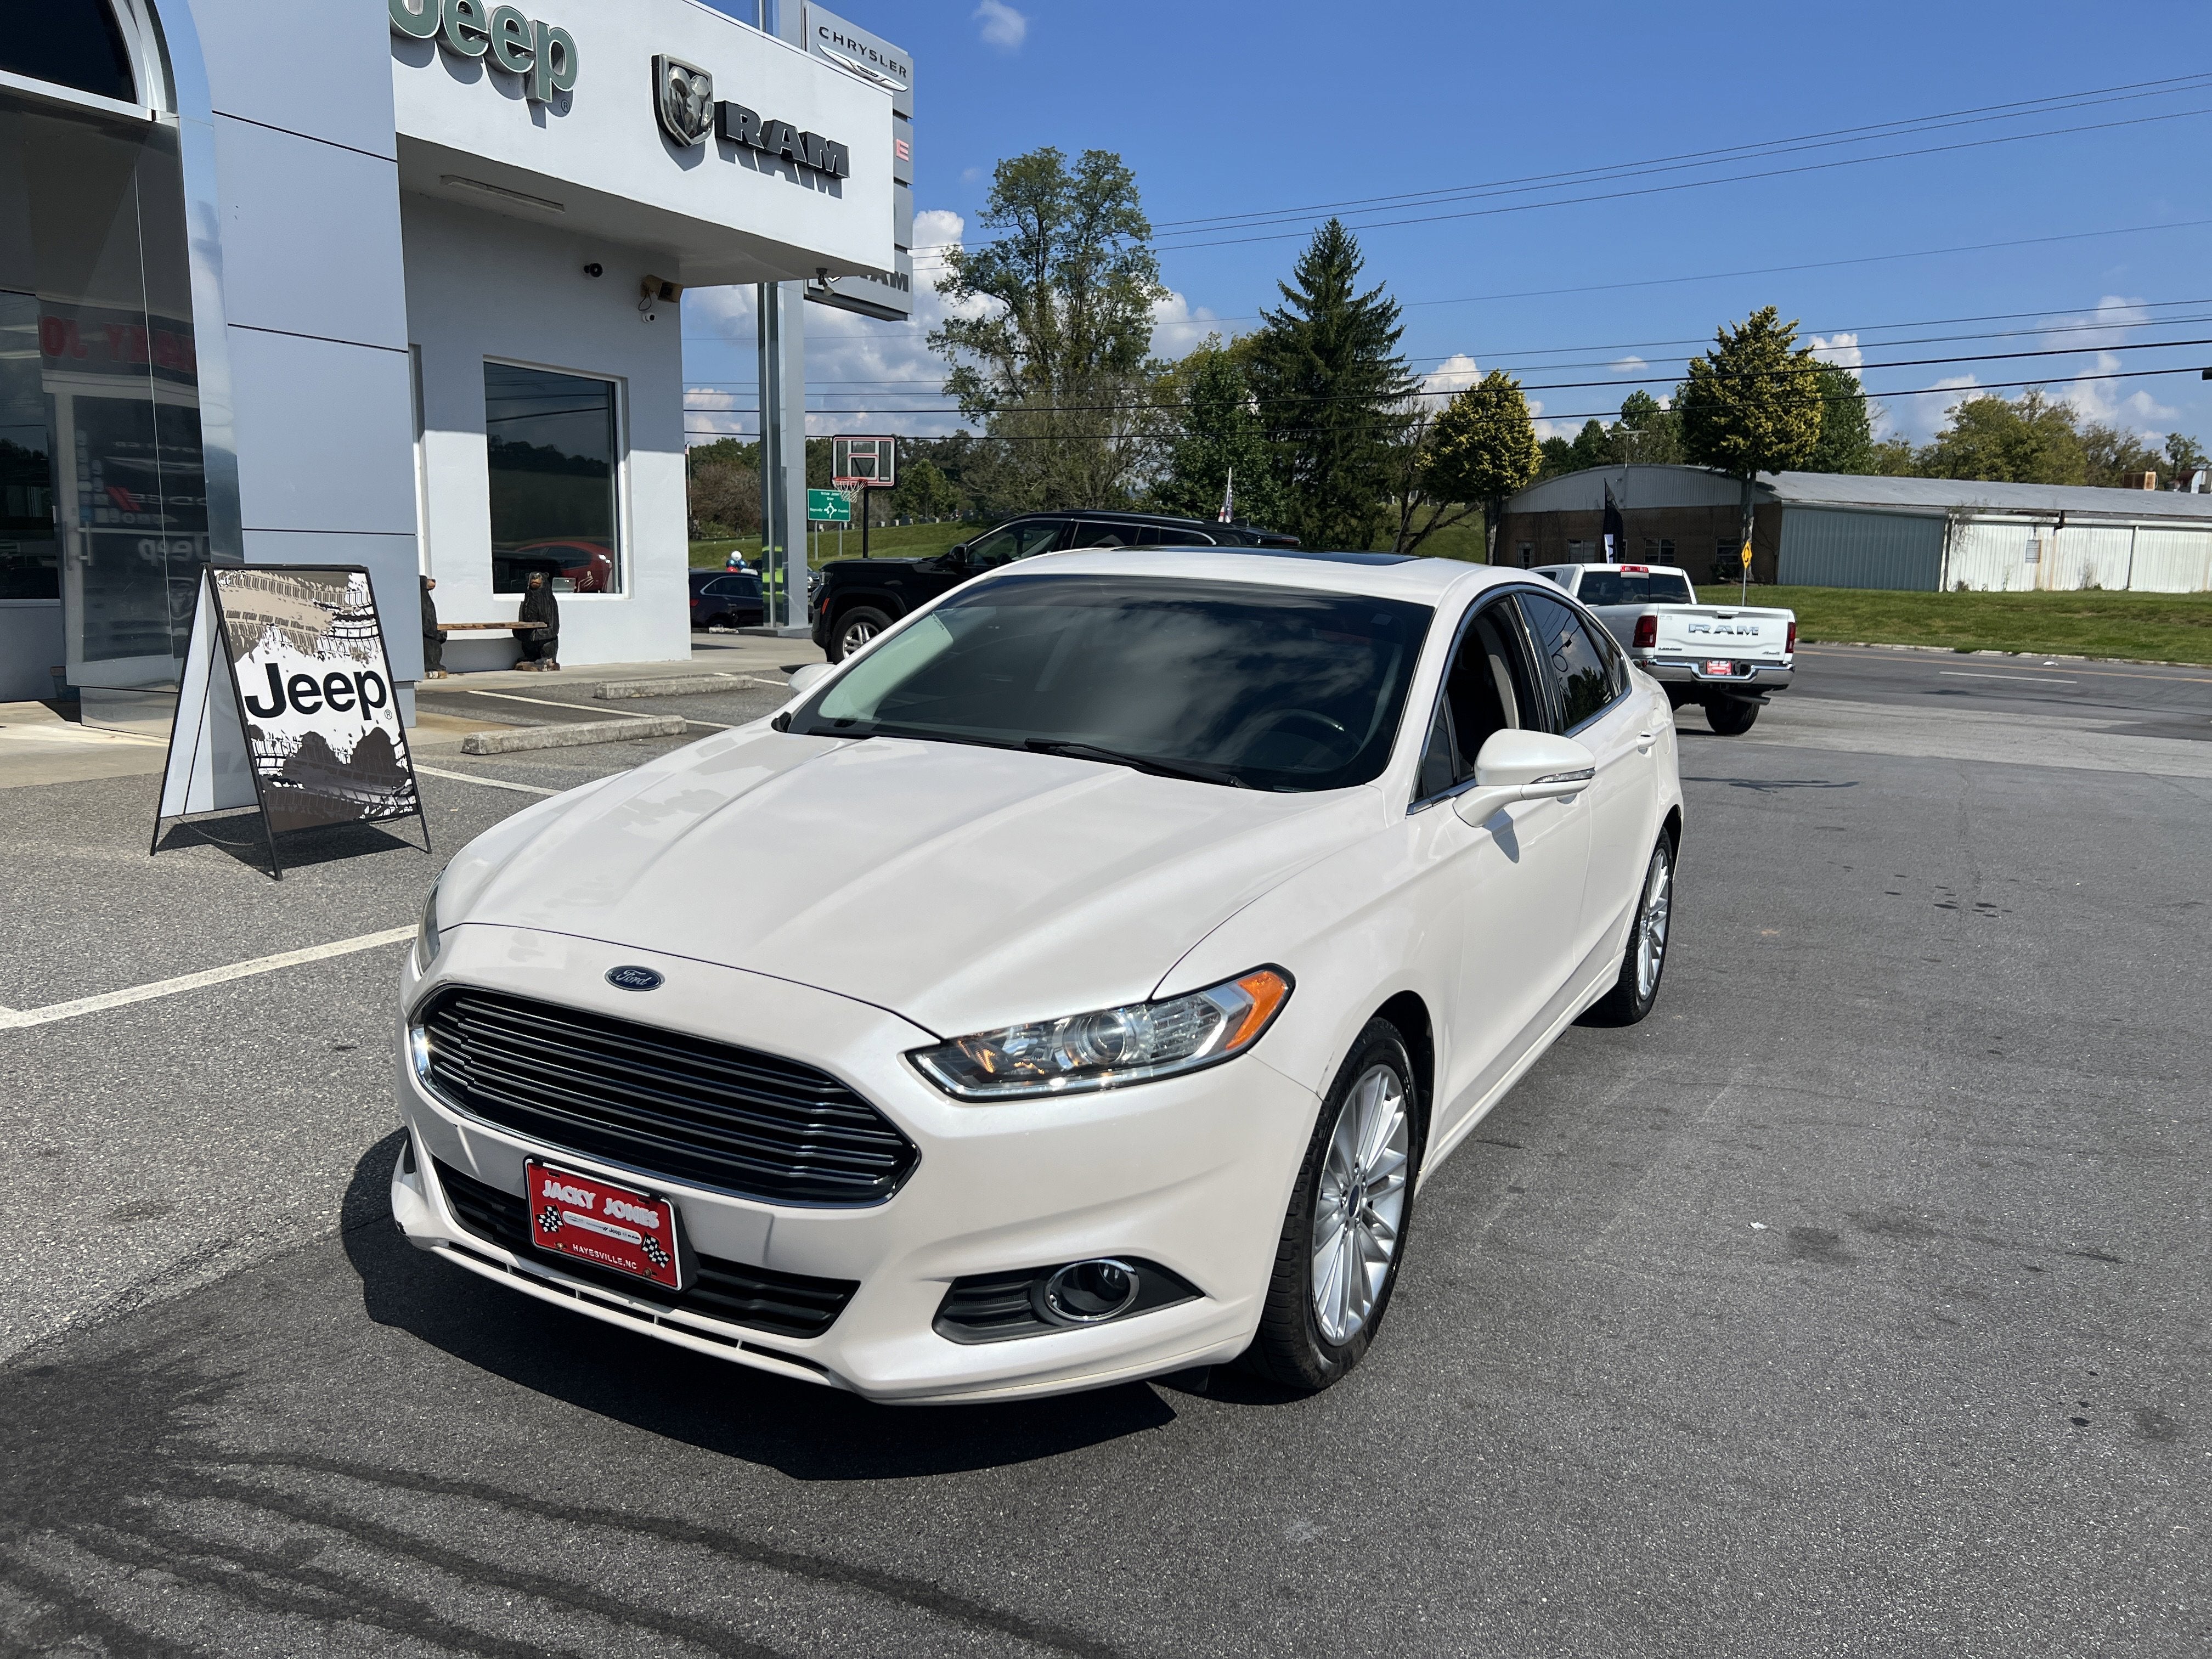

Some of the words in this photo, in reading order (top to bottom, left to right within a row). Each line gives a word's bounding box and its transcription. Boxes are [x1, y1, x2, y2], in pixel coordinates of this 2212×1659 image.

[818, 26, 907, 78] CHRYSLER
[714, 100, 850, 178] RAM
[860, 271, 909, 292] AM
[1688, 623, 1759, 636] RAM
[244, 663, 387, 721] Jeep
[616, 969, 652, 985] Ford
[542, 1180, 596, 1209] JACKY
[603, 1198, 659, 1229] JONES
